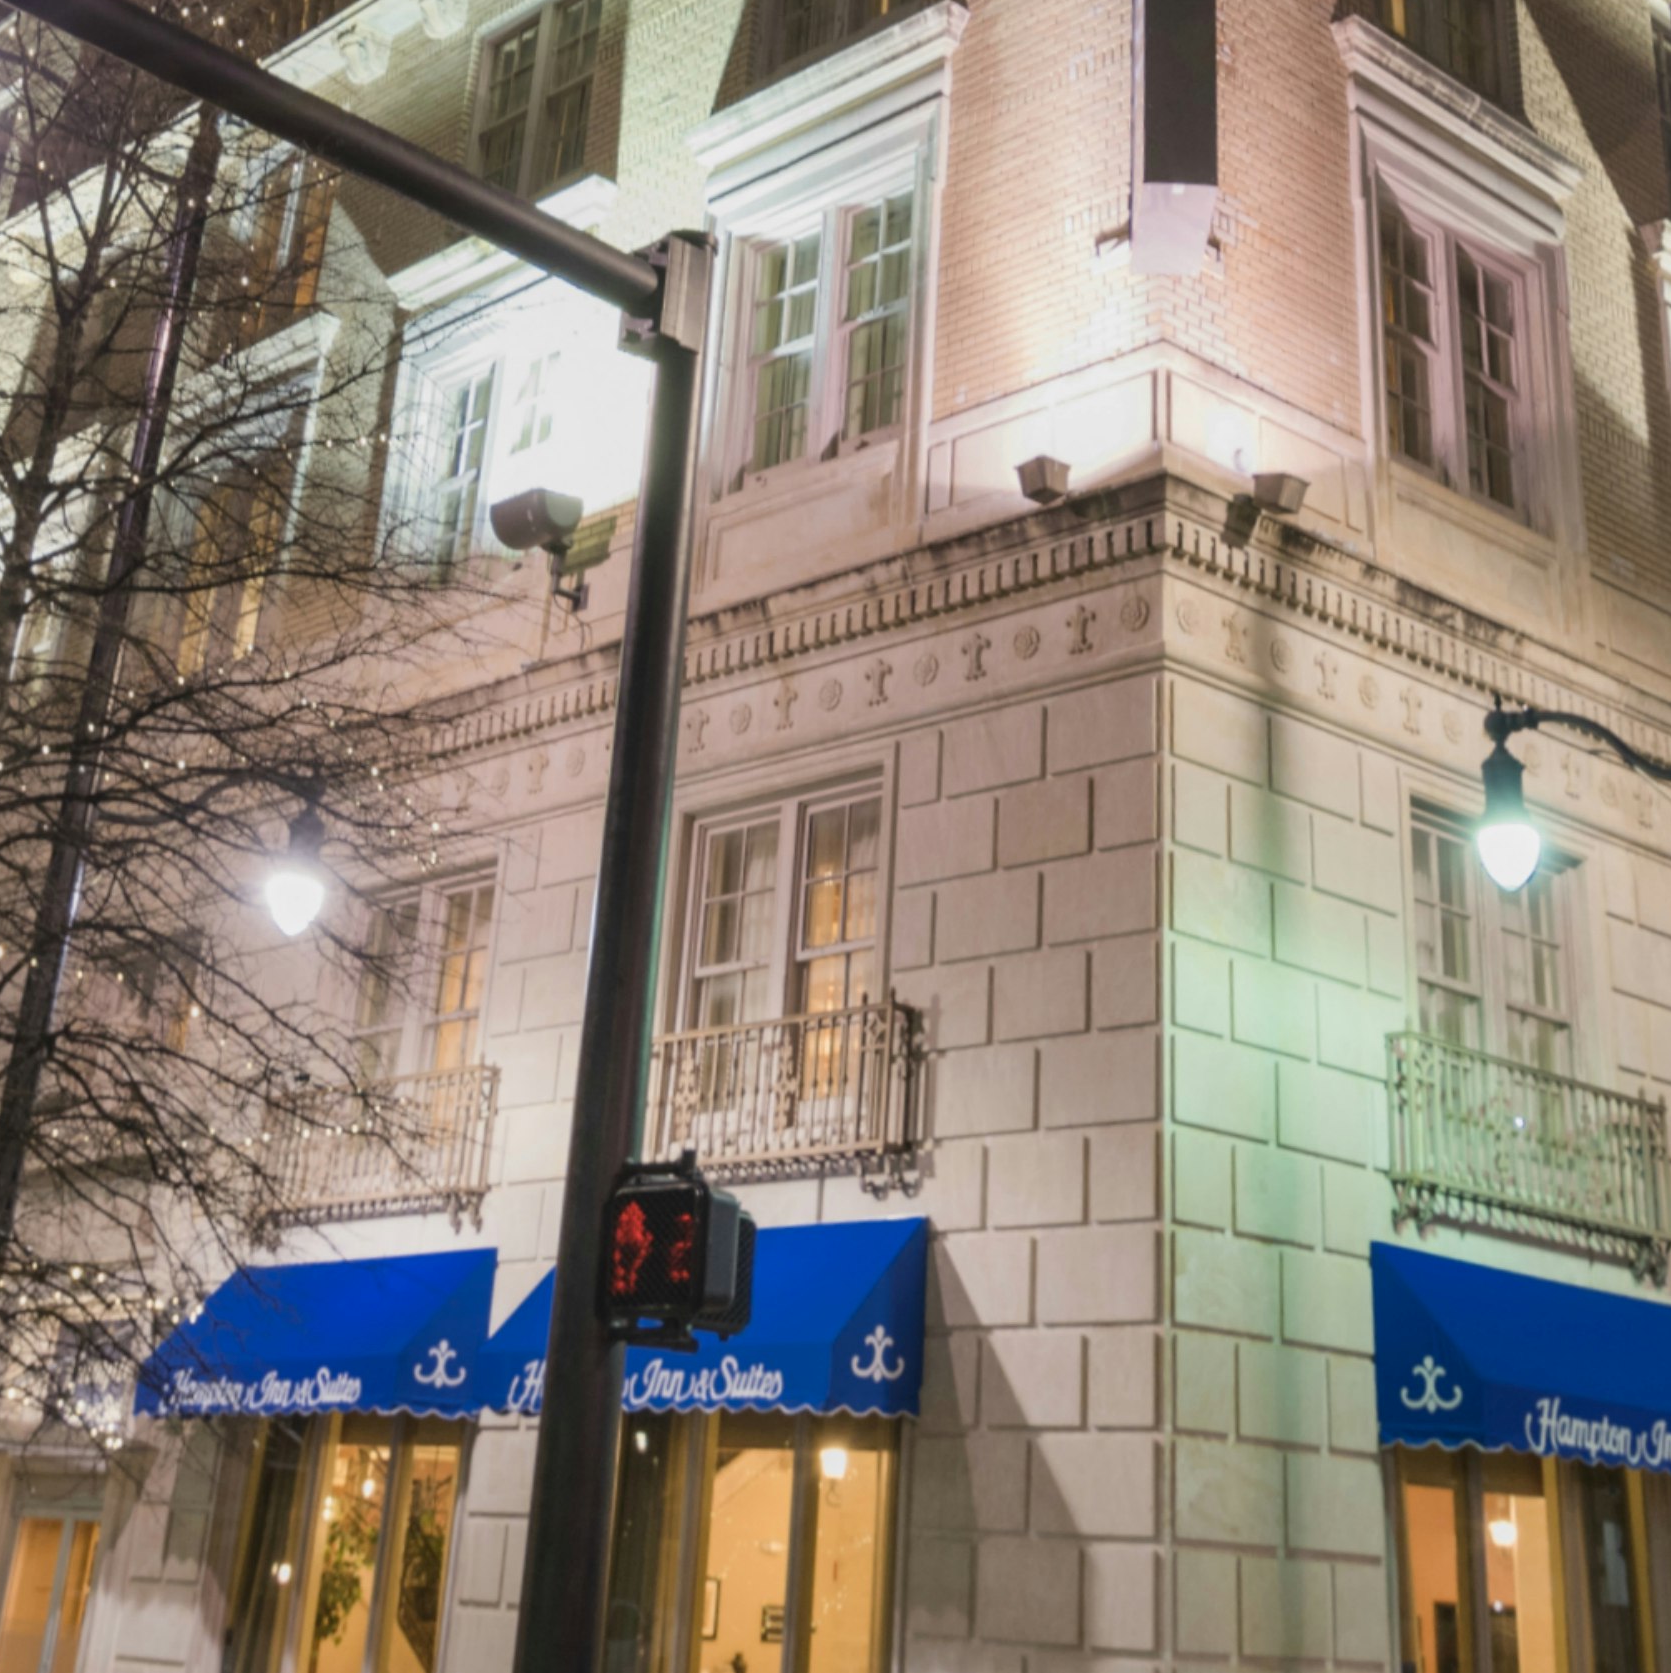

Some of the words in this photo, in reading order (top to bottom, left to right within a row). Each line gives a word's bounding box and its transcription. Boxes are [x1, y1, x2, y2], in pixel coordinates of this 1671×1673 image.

[246, 1370, 295, 1409] Inn
[308, 1366, 361, 1405] Suites
[630, 1358, 694, 1405] Inn
[709, 1355, 783, 1401] Suites
[1525, 1396, 1641, 1464] Hampton
